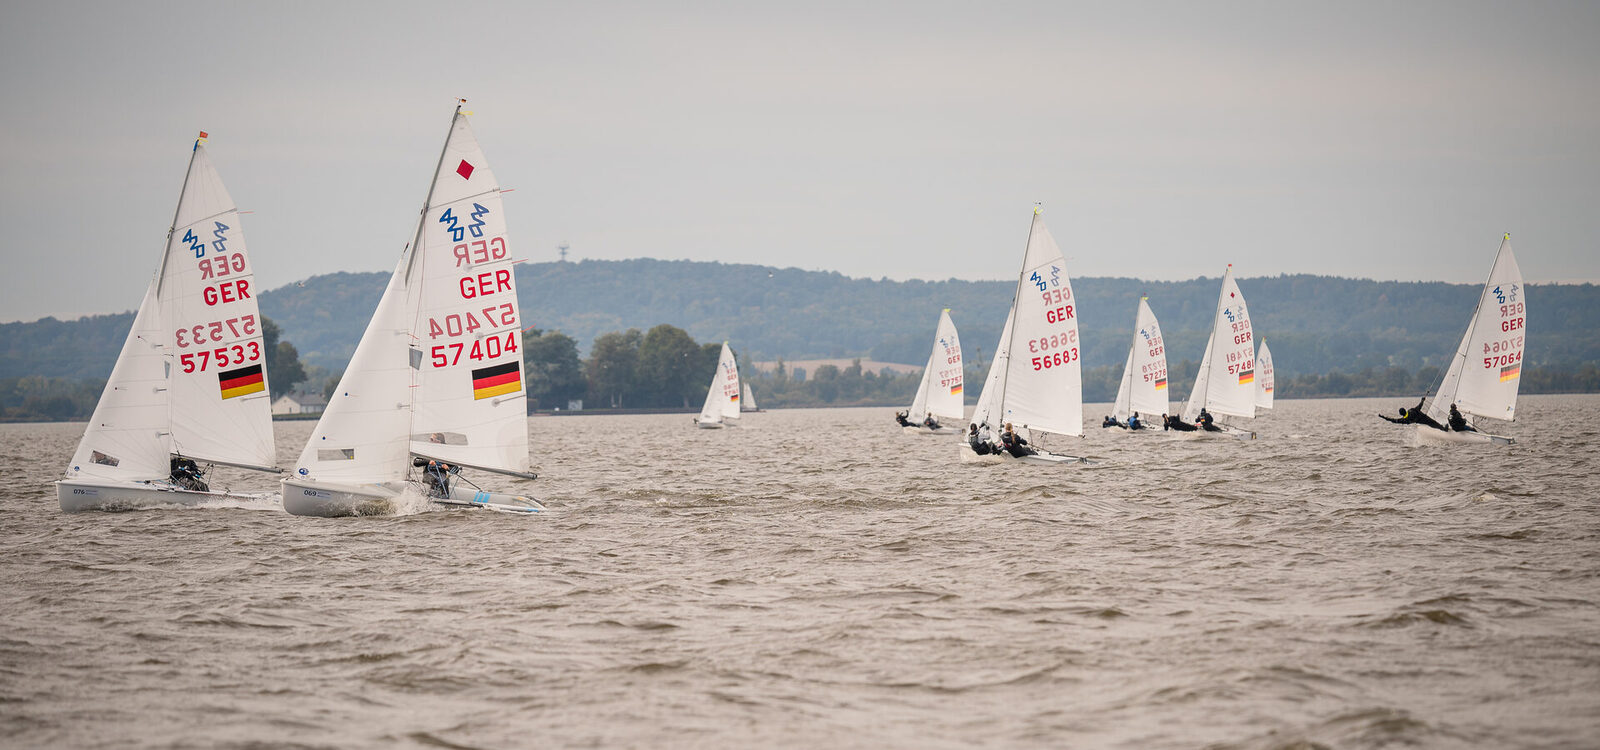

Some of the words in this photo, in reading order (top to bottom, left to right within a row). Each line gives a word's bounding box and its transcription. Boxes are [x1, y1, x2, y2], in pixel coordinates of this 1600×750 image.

[203, 280, 251, 306] GER
[460, 269, 511, 299] GER
[1046, 305, 1074, 324] GER
[1501, 317, 1524, 332] GER
[1234, 331, 1252, 345] GER
[180, 341, 260, 373] 57533
[431, 332, 518, 368] 57404
[1032, 347, 1078, 371] 56683
[1149, 346, 1163, 357] GER
[1483, 350, 1522, 369] 57064
[1143, 368, 1167, 382] 57278
[1228, 358, 1255, 375] 57481
[303, 489, 317, 497] 069
